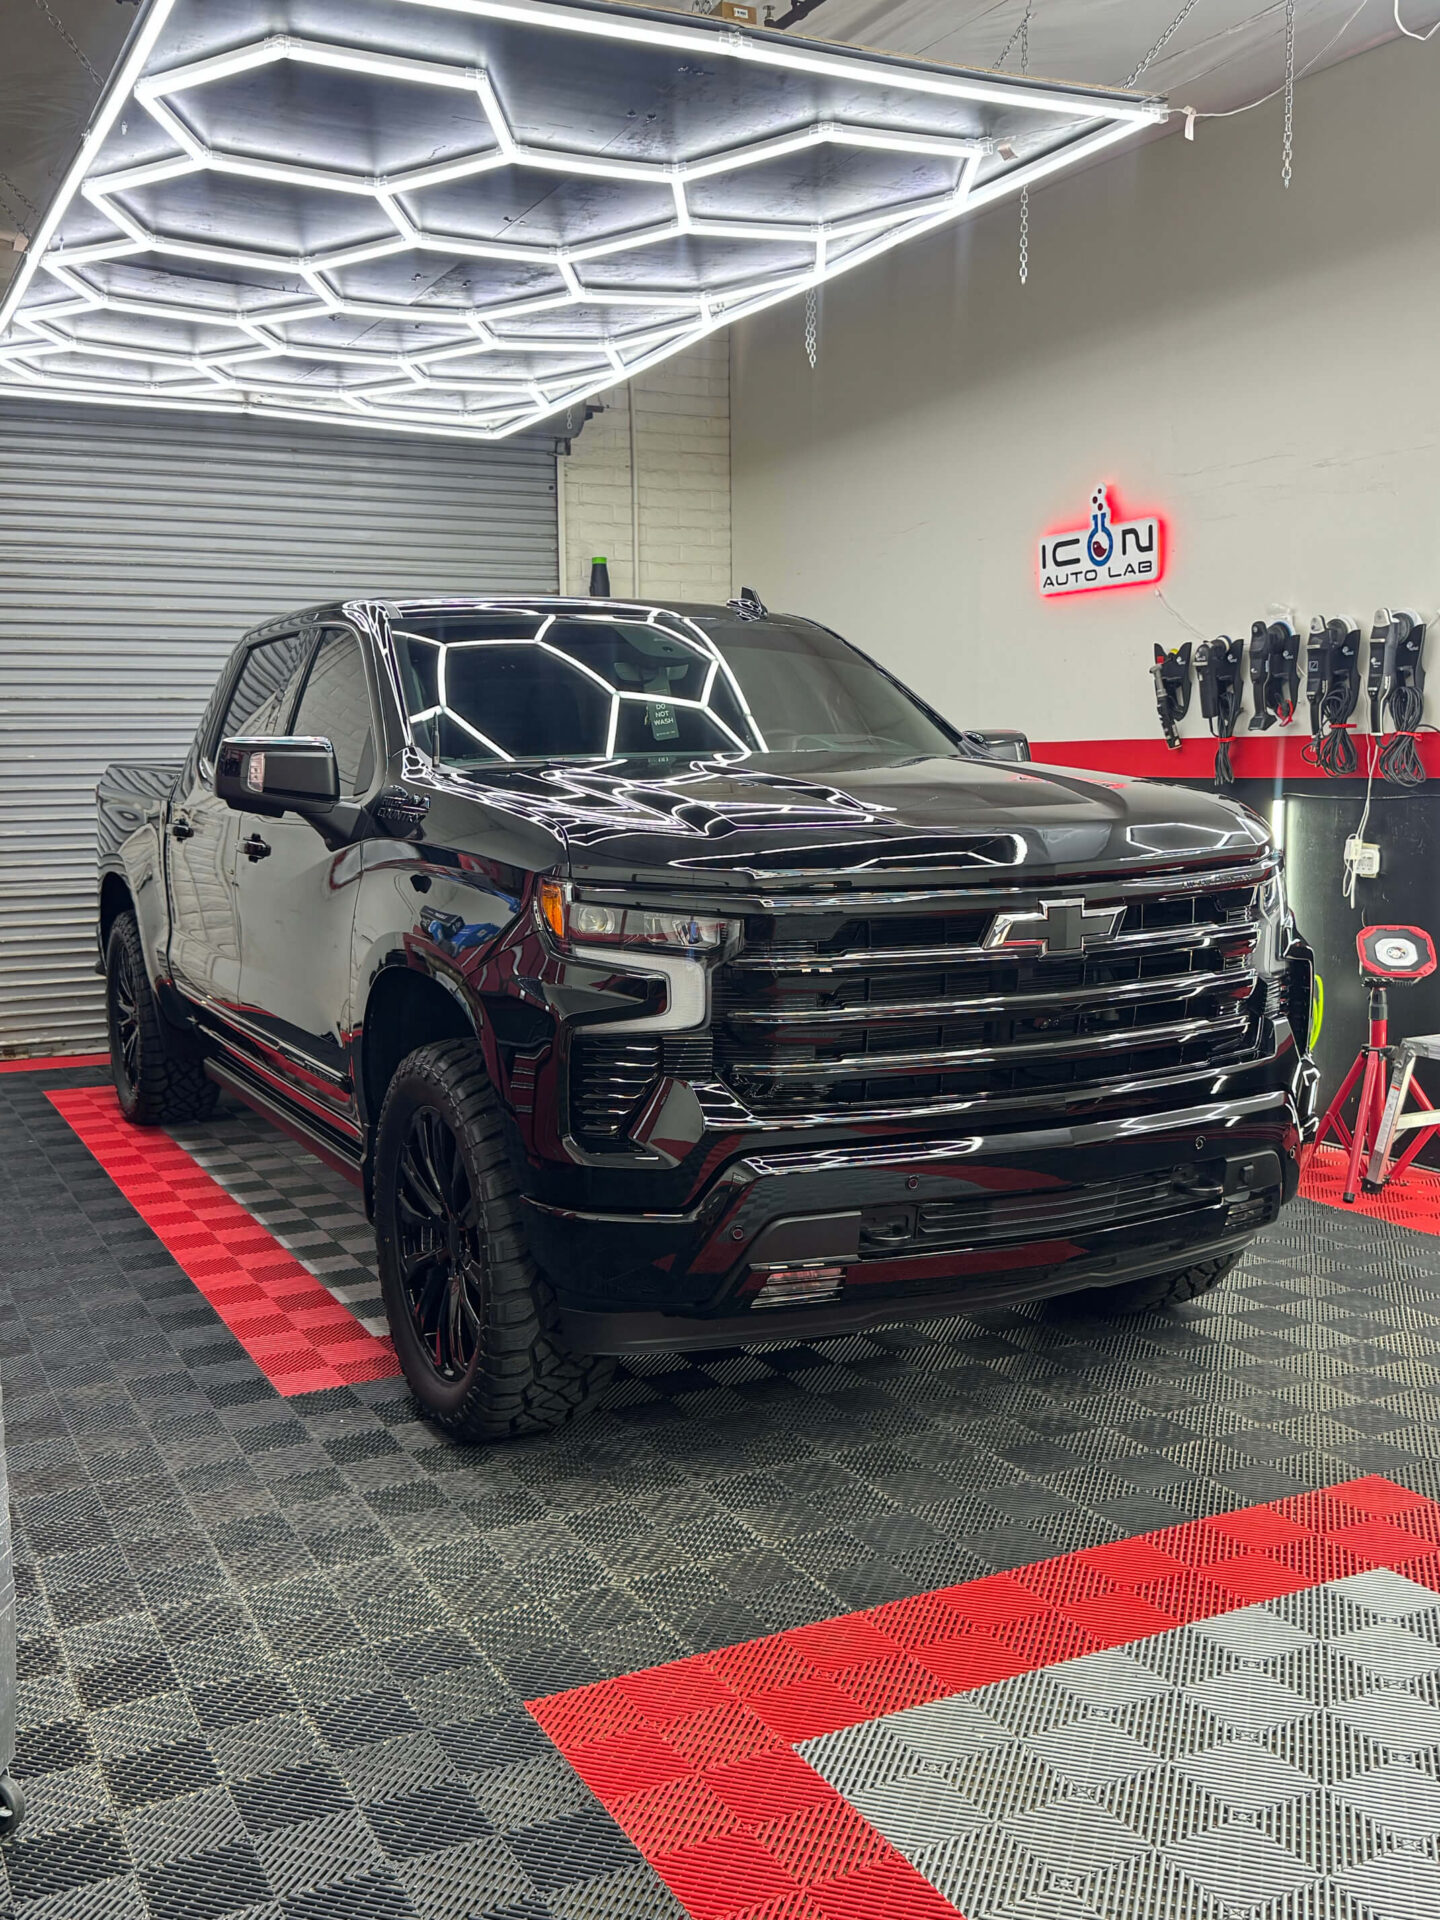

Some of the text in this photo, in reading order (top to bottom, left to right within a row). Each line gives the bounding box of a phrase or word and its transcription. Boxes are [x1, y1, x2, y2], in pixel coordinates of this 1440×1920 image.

[1042, 513, 1153, 569] ICON
[1043, 560, 1153, 589] AUTO LAB
[654, 717, 674, 726] WASH
[377, 808, 425, 823] COUNTRY
